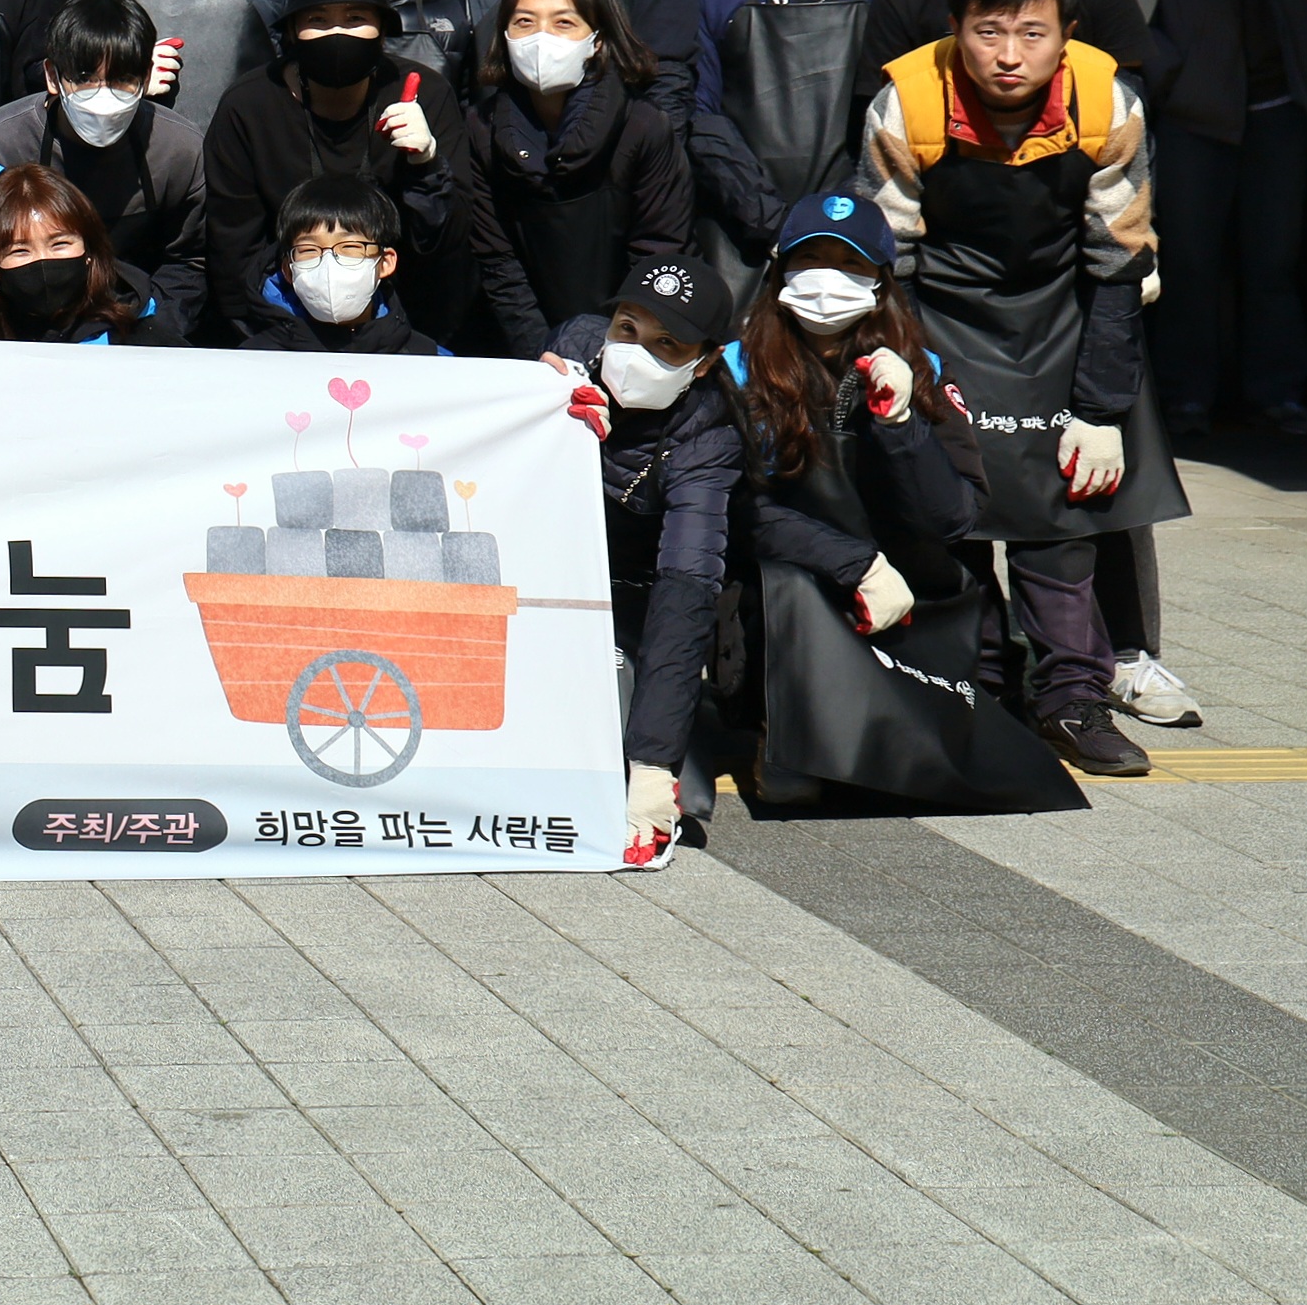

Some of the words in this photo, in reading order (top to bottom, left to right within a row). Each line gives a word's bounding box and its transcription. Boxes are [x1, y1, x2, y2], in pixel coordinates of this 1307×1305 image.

[42, 812, 201, 845] 주최/주관
[254, 810, 367, 849] 희망을
[379, 811, 454, 849] 파는
[467, 815, 580, 855] 사람들
